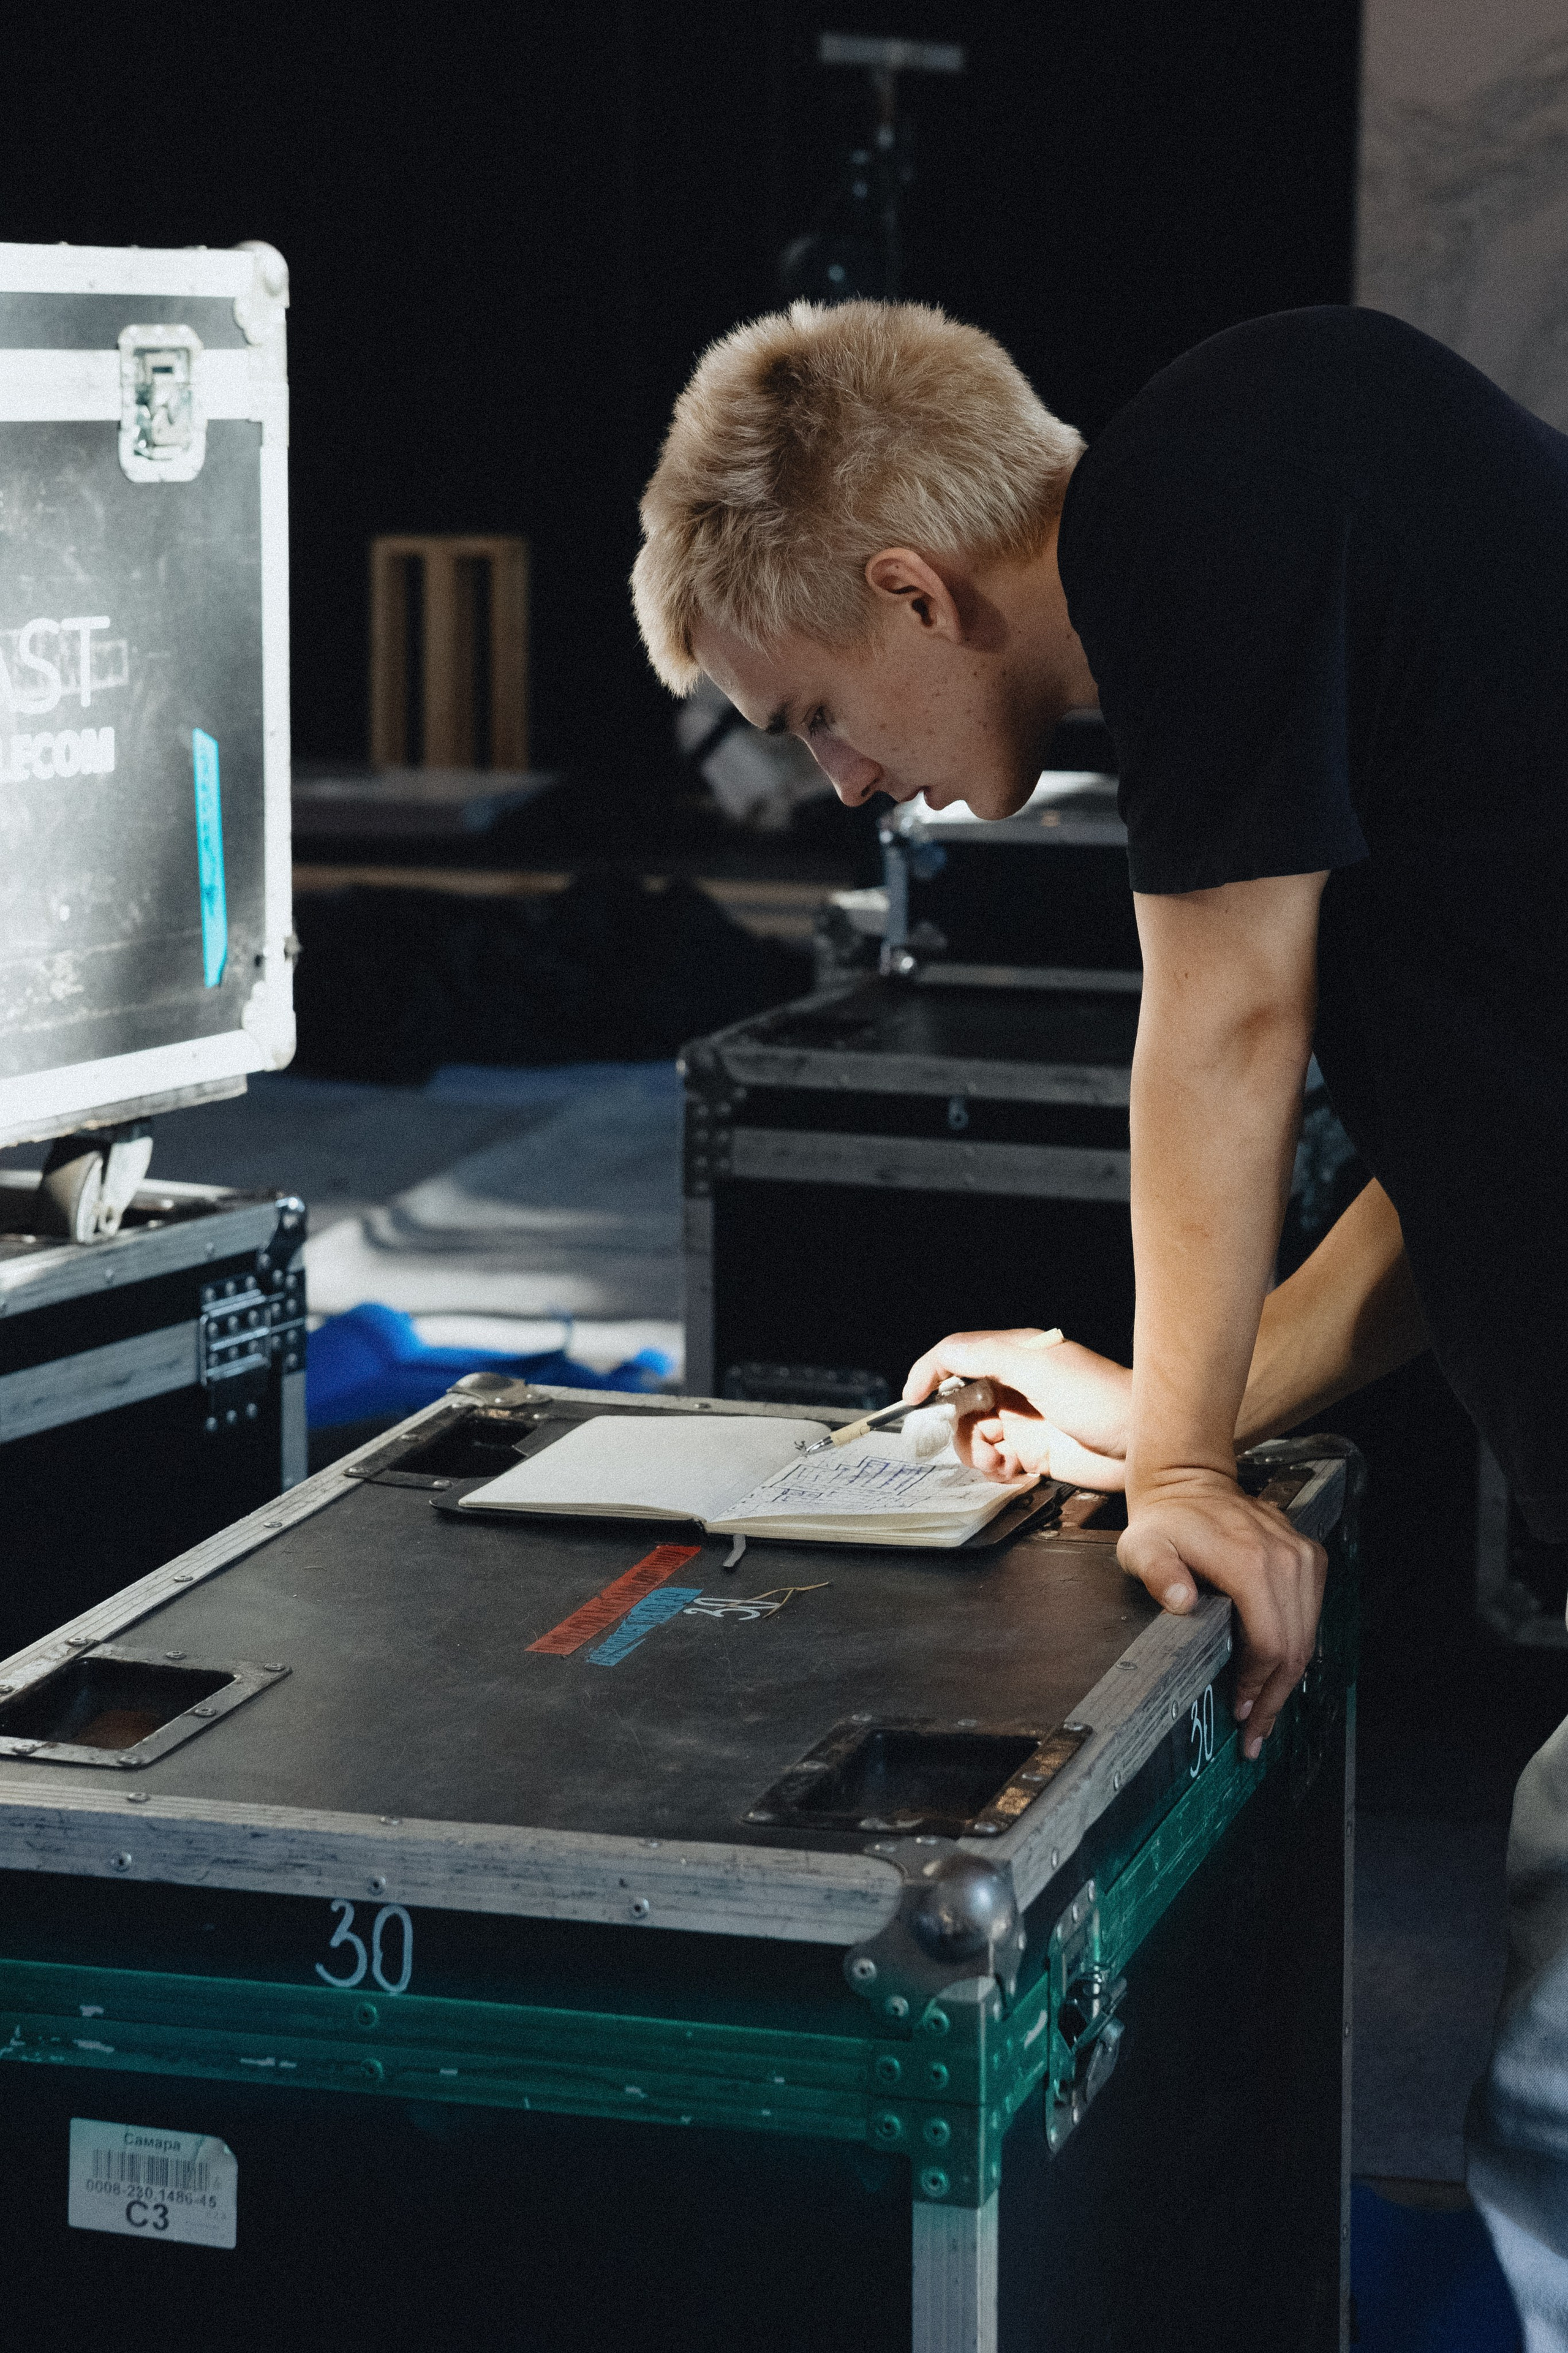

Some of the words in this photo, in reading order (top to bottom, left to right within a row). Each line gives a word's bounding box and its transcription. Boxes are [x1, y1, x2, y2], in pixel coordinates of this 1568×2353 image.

[1190, 1684, 1213, 1778] 30
[315, 1899, 413, 1993] 30
[124, 2132, 181, 2151] Самара
